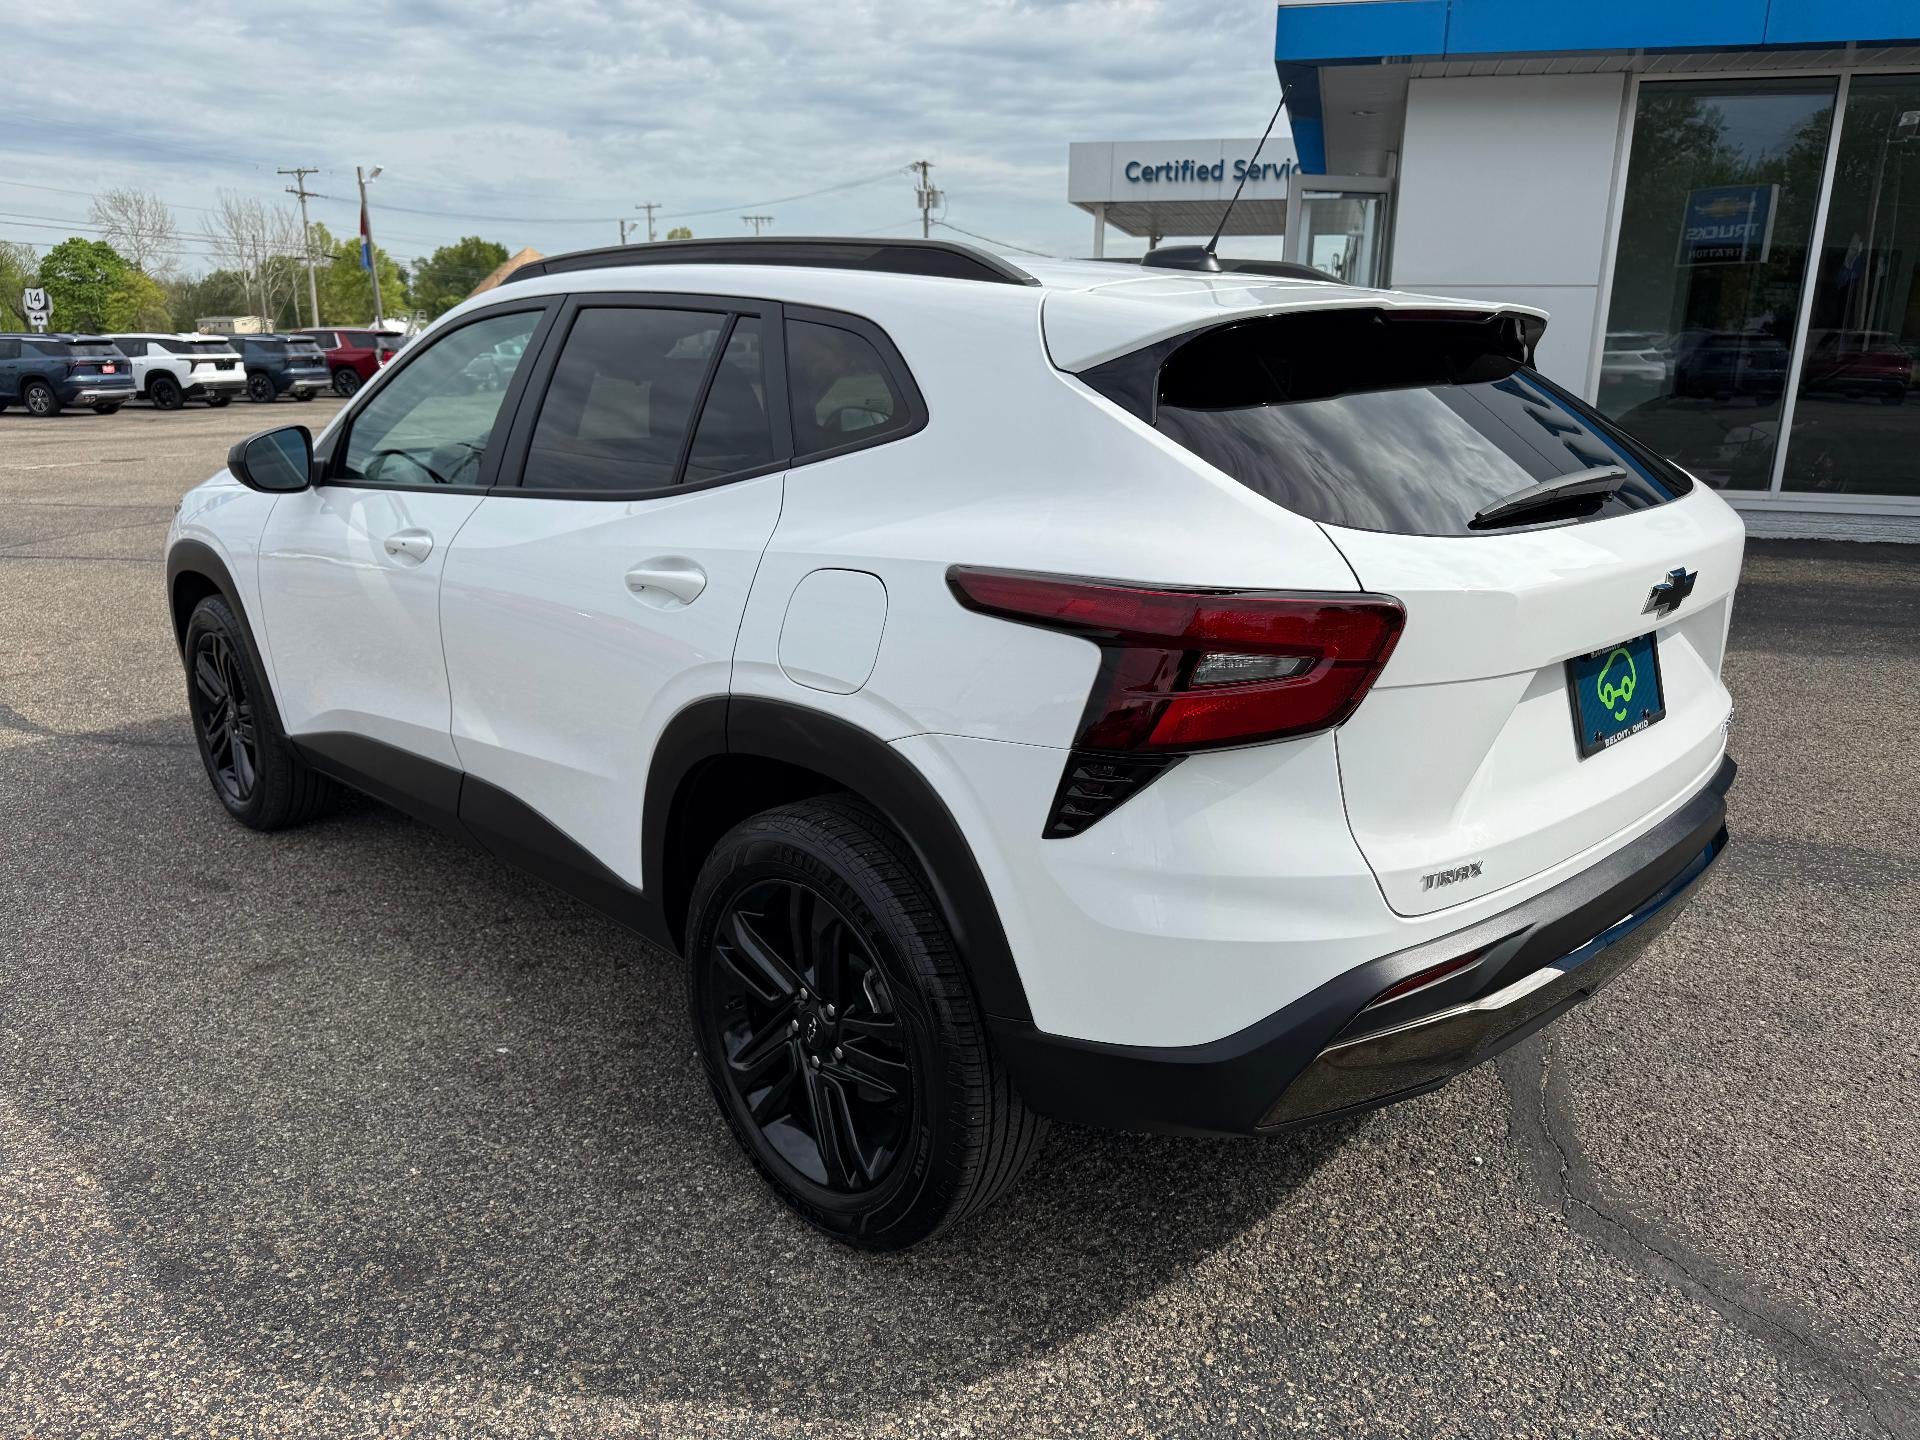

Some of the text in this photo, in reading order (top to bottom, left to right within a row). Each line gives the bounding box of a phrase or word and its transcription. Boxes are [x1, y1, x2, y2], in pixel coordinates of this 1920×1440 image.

[1125, 159, 1224, 183] Certified
[29, 292, 42, 305] 14
[1632, 720, 1649, 733] OHIO
[1420, 860, 1484, 893] TRAX
